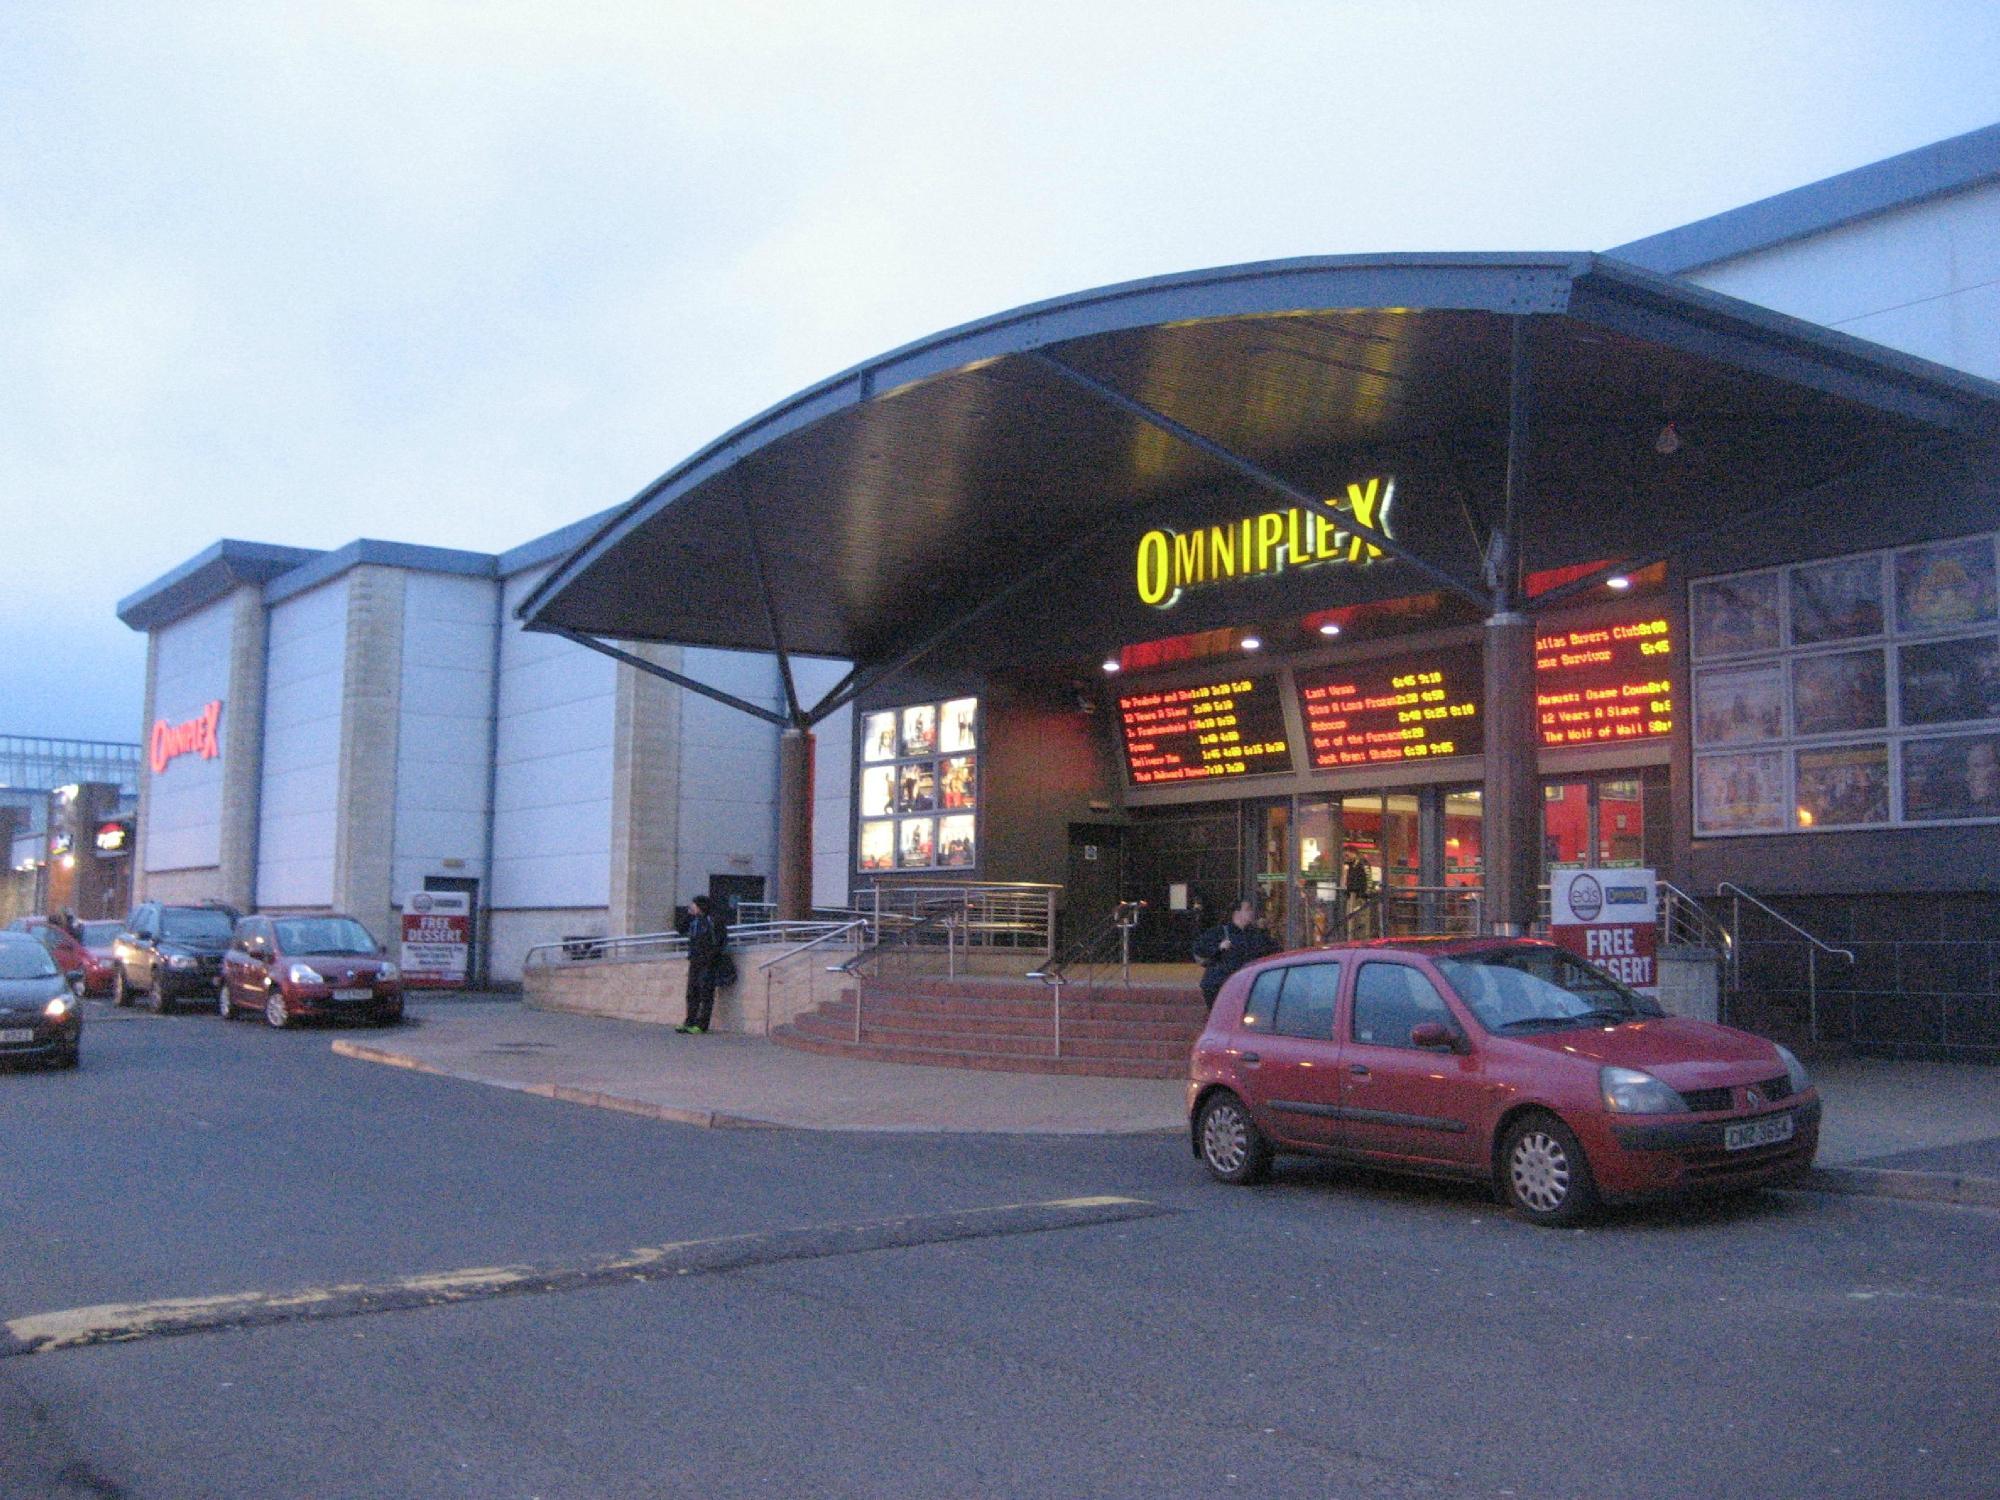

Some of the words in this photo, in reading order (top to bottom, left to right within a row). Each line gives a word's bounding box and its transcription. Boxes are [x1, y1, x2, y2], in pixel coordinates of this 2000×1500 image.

[1137, 478, 1383, 604] OMNIPLEX
[1641, 640, 1669, 654] 5:45
[1542, 713, 1555, 724] 12
[1558, 711, 1591, 722] Years
[1594, 707, 1603, 718] A
[1607, 705, 1641, 717] Slave
[1544, 731, 1564, 742] The
[1567, 727, 1593, 740] Wolf
[1598, 725, 1612, 737] of
[1616, 723, 1643, 736] Wall
[1585, 927, 1635, 956] FREE
